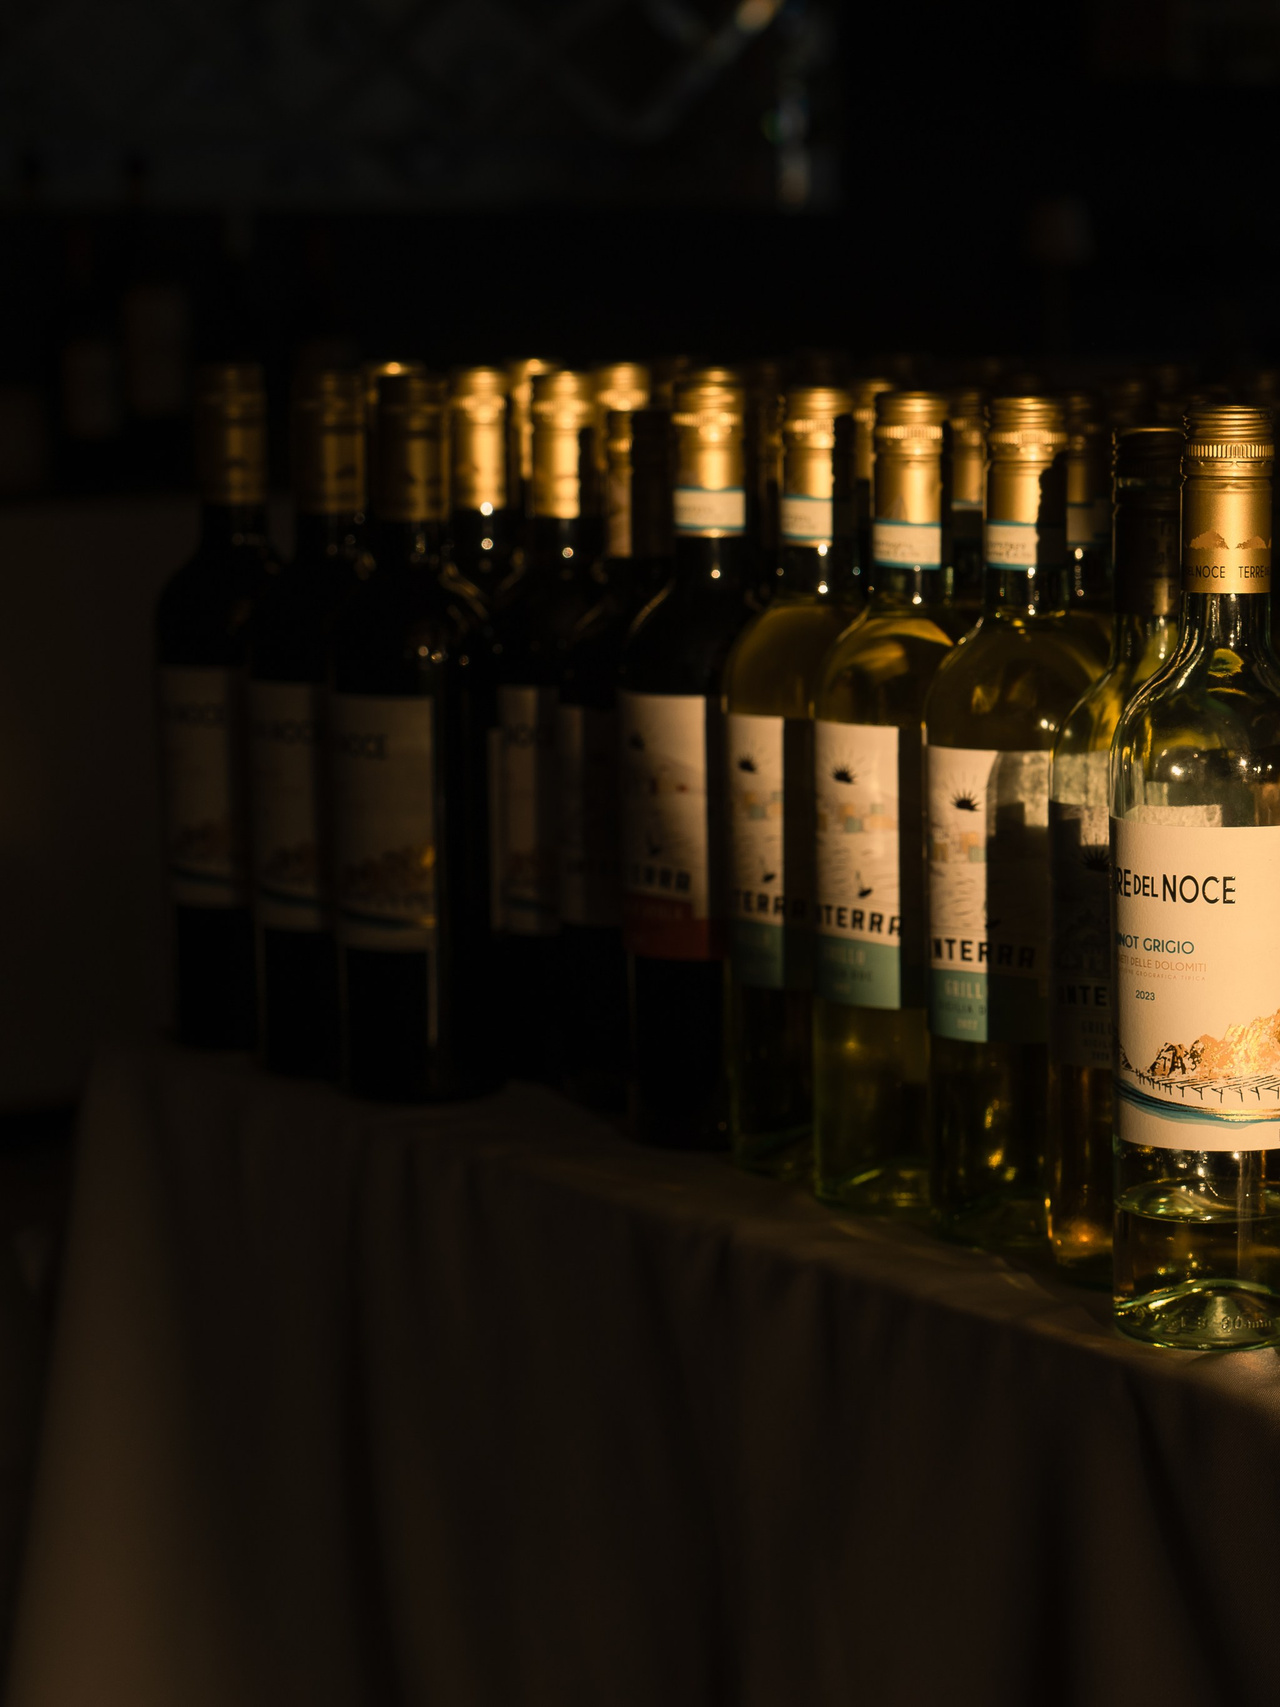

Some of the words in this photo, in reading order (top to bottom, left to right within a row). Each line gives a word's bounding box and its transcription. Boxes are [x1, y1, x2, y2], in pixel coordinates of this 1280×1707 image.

[1195, 565, 1226, 578] NOCE
[1238, 565, 1264, 578] TERRE
[1134, 874, 1158, 897] DEL
[1163, 874, 1236, 904] NOCE
[1143, 937, 1195, 954] GRIGIO
[1131, 956, 1152, 968] DELLE
[1155, 960, 1207, 972] DOLOMITI
[1136, 970, 1177, 980] GEOGRAFICA
[1135, 989, 1156, 1001] 2023
